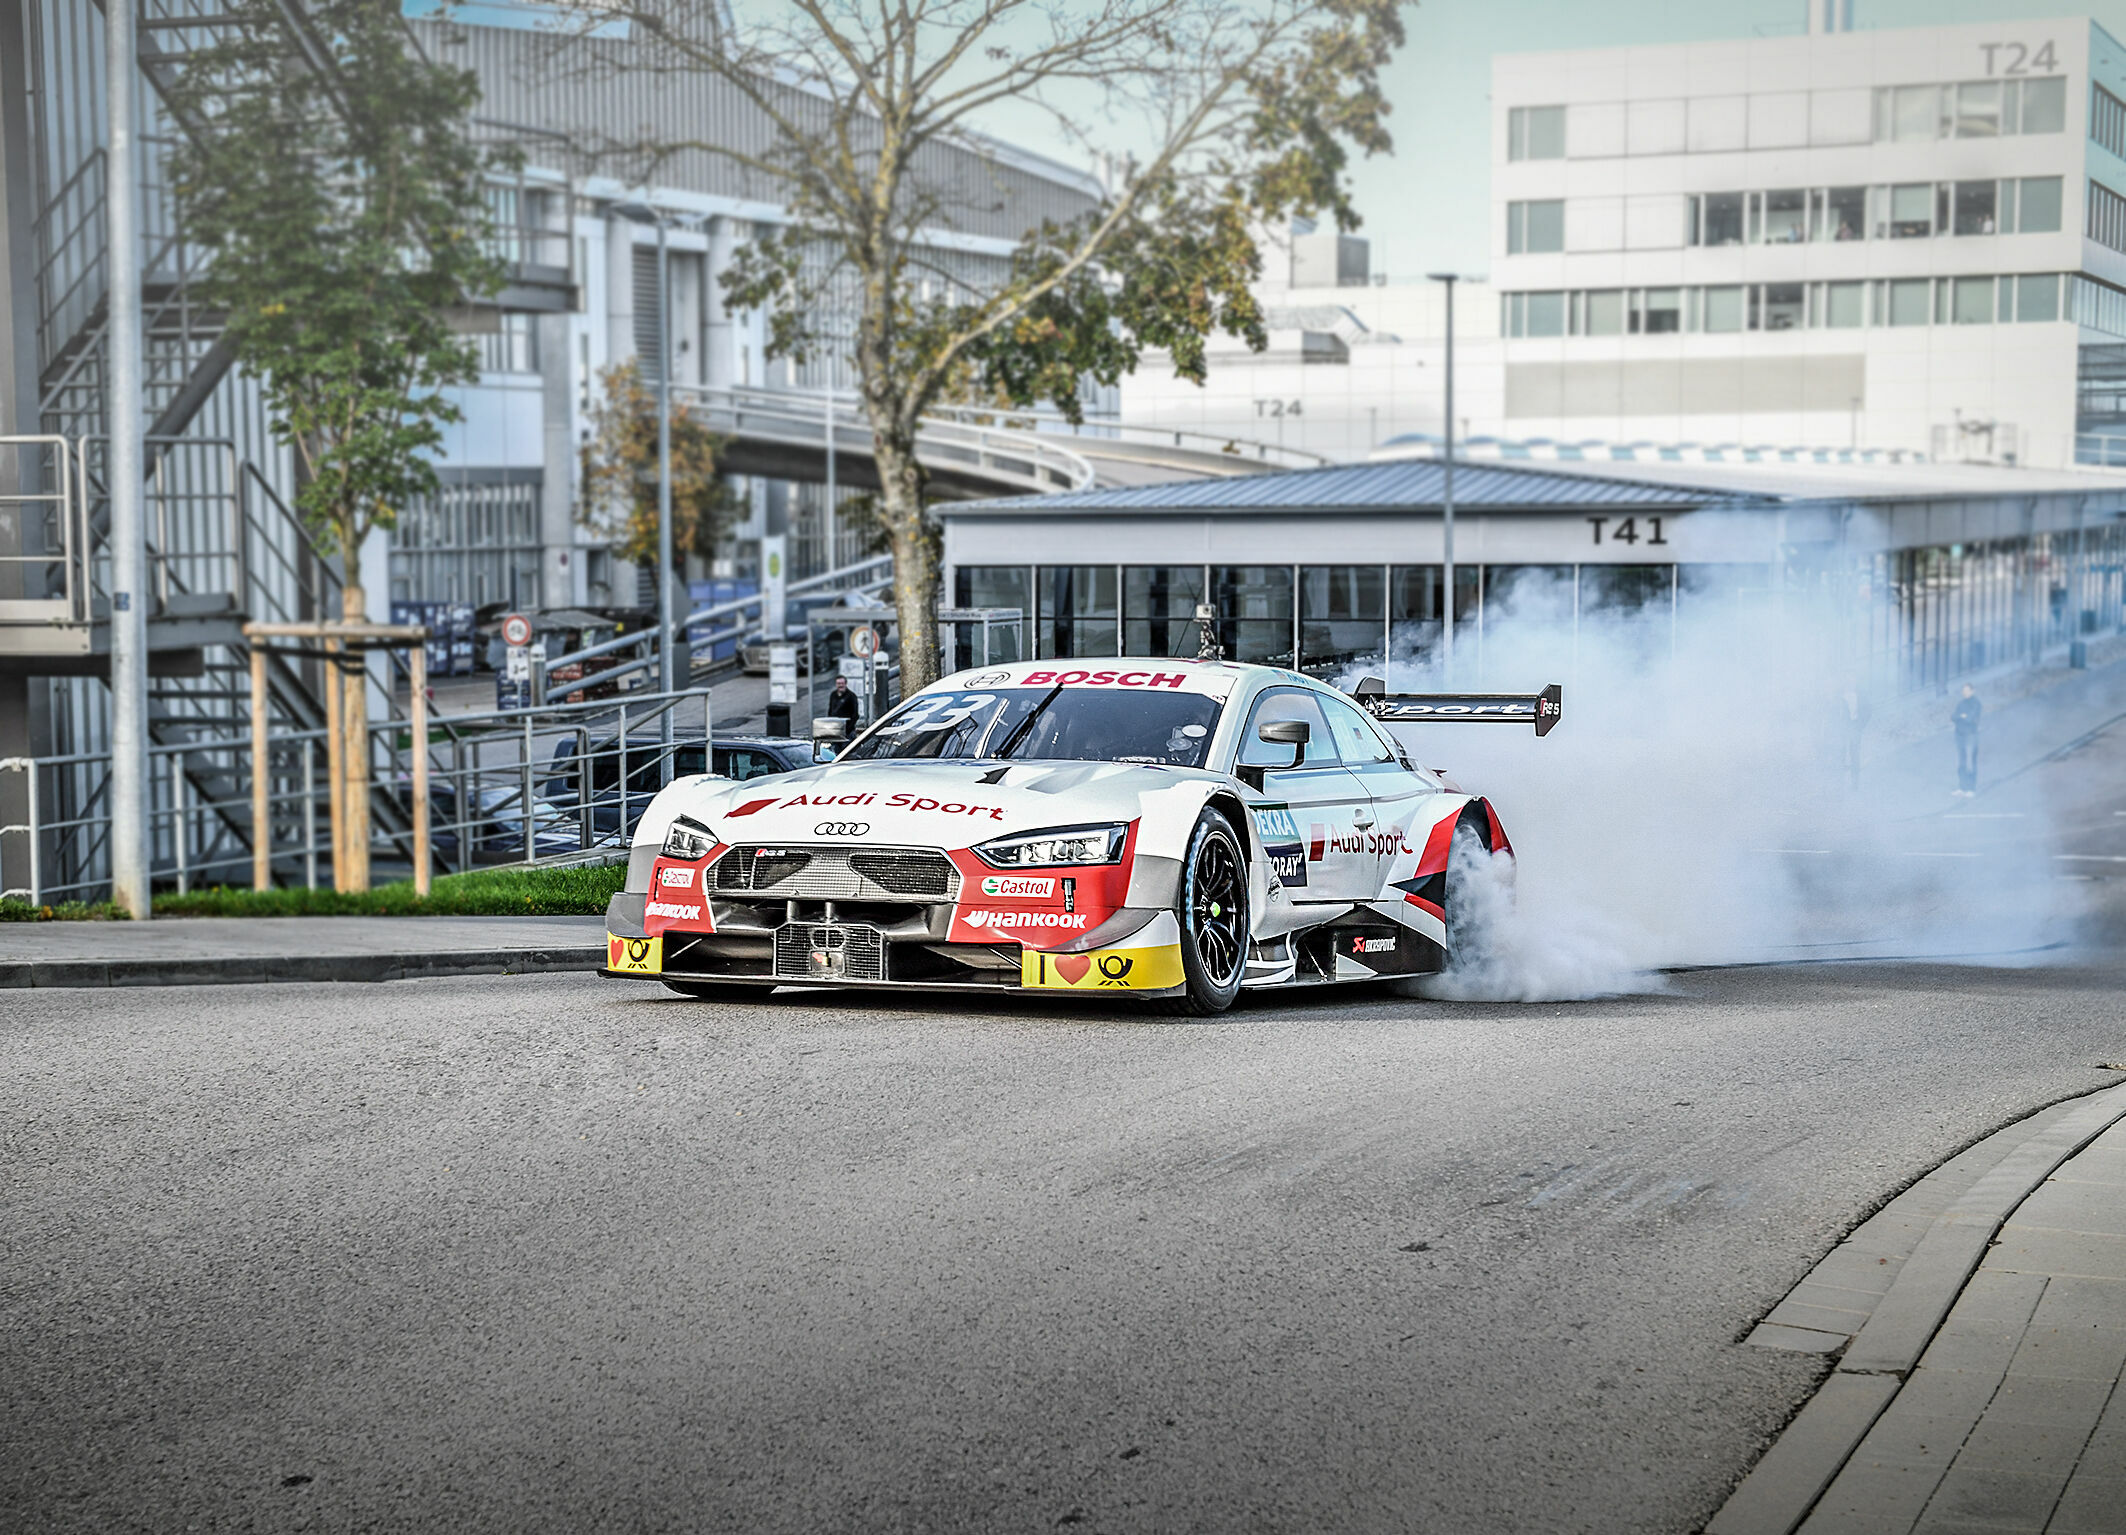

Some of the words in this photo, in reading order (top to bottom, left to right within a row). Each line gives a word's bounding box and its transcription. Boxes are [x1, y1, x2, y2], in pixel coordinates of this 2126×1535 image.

[1978, 39, 2060, 76] T24
[1252, 398, 1303, 418] T24
[1586, 515, 1668, 545] T41
[1020, 670, 1188, 688] BOSCH
[875, 694, 997, 736] 33
[778, 793, 878, 810] Audi
[885, 793, 1004, 821] Sport
[1329, 824, 1365, 854] Audi
[1367, 826, 1414, 862] Sport
[1000, 879, 1049, 895] Castrol
[1039, 954, 1046, 985] I
